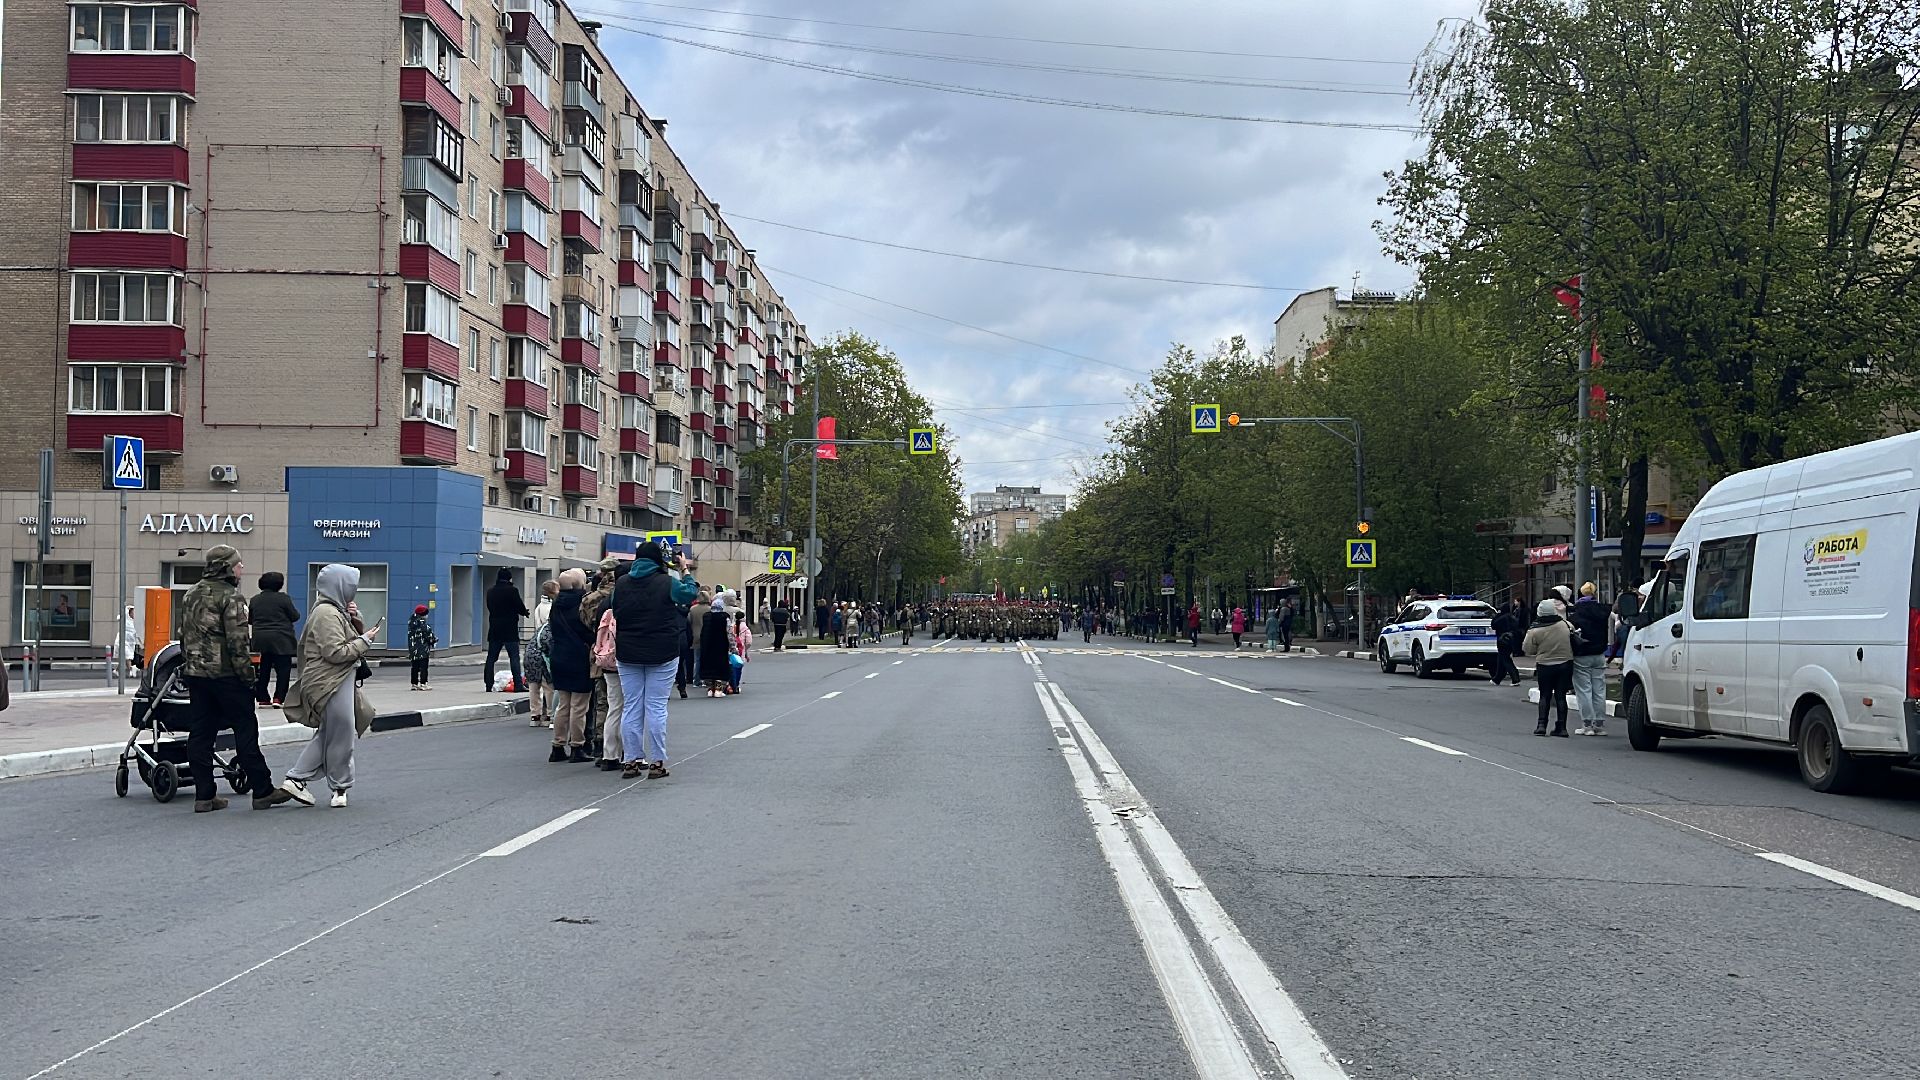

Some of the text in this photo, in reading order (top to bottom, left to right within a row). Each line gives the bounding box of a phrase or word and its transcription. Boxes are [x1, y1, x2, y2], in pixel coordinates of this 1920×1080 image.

[19, 515, 87, 525] ЮВИРНЫЙ
[140, 513, 254, 535] АДАМАС
[313, 519, 381, 529] ЮВЕЛИРНЫЙ
[28, 526, 76, 535] МАЗИН
[323, 529, 371, 538] МАГАЗИН
[1818, 537, 1858, 553] РАБОТА
